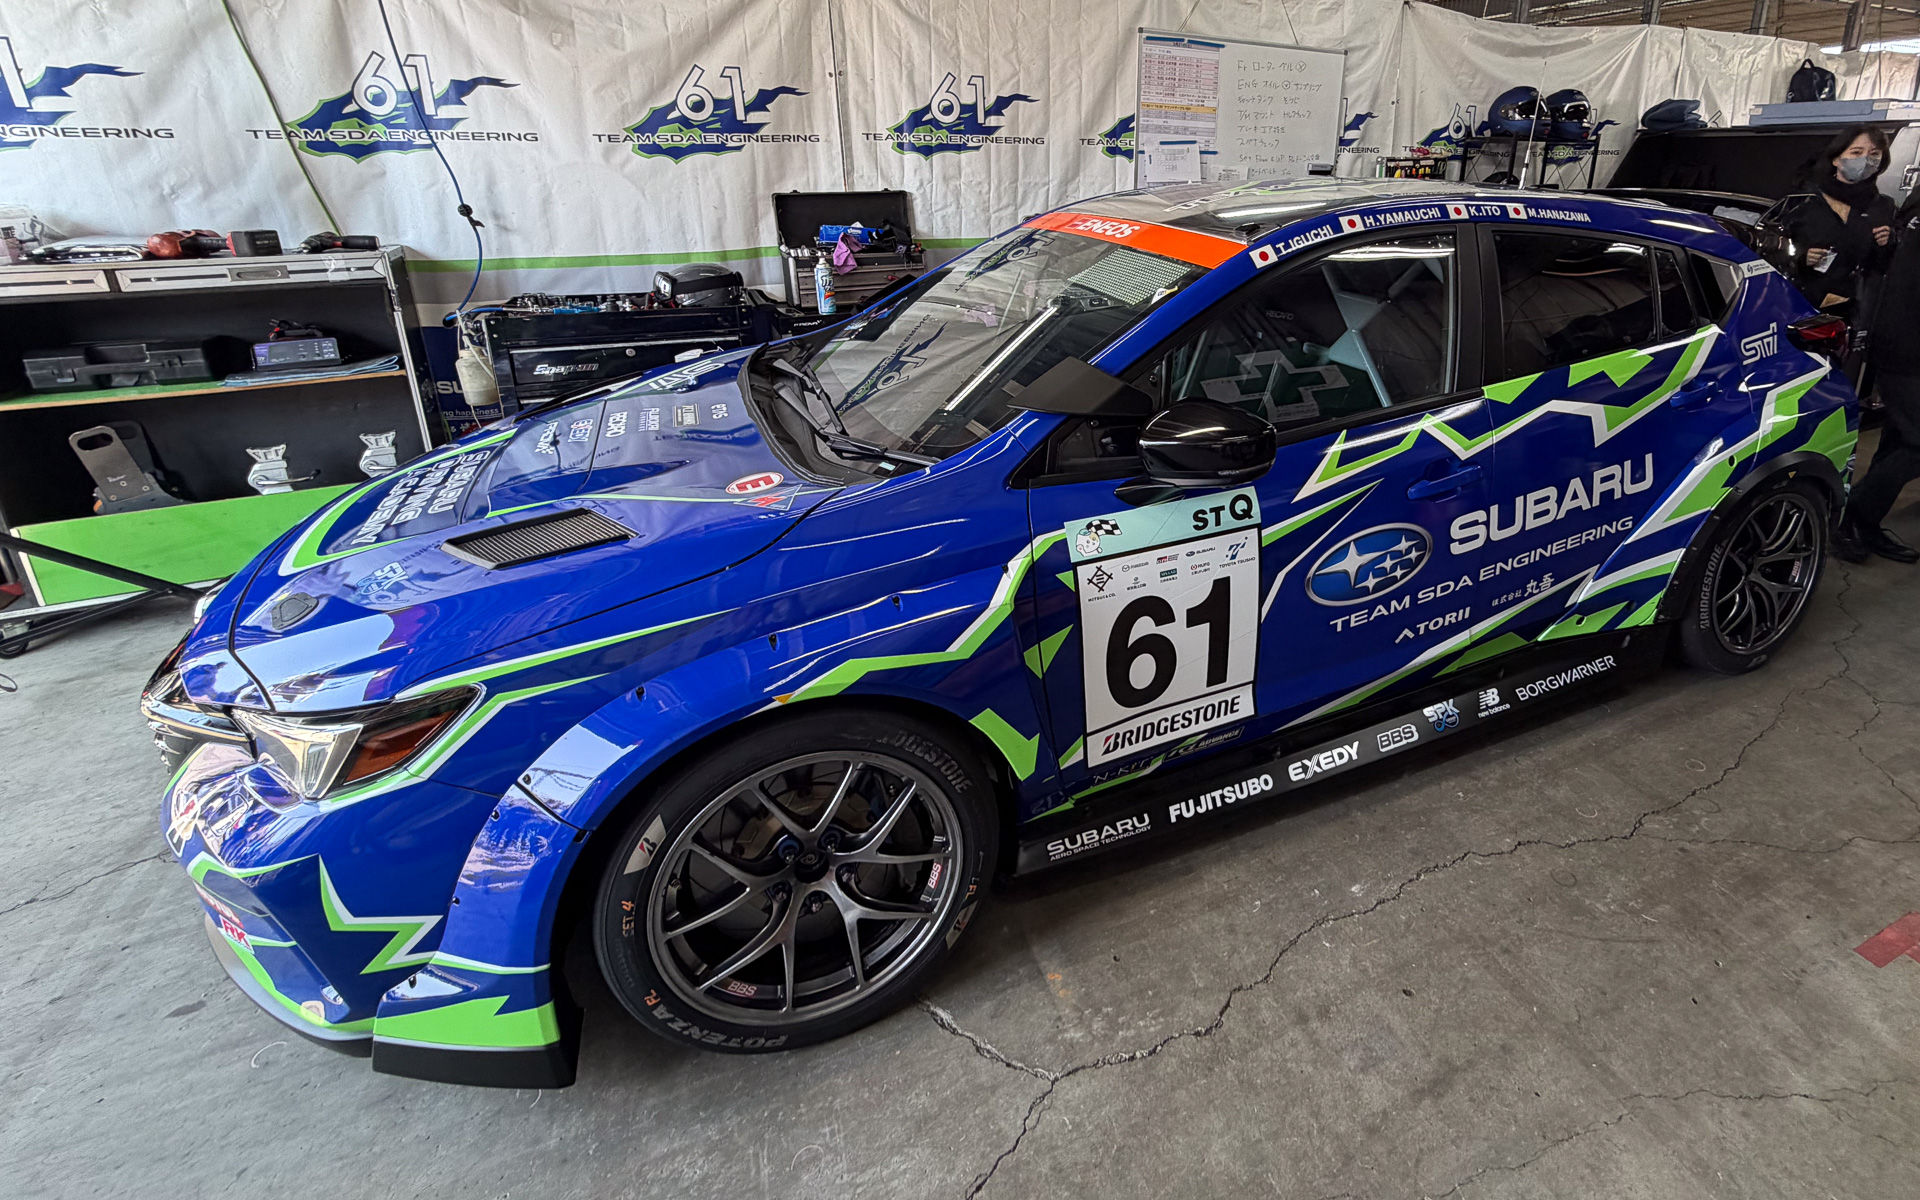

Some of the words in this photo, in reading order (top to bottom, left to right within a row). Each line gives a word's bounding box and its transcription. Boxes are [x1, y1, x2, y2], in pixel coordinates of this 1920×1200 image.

[352, 51, 437, 116] 61
[675, 64, 746, 121] 61
[930, 72, 986, 124] 61
[1237, 79, 1258, 90] ENG
[246, 129, 326, 140] TEAM
[328, 130, 386, 141] SDA
[388, 130, 539, 142] ENGINEERING
[592, 133, 652, 143] TEAM
[655, 133, 699, 143] SDA
[702, 133, 820, 143] ENGINEERING
[862, 132, 910, 142] TEAM
[912, 133, 947, 143] SDA
[949, 134, 1045, 145] ENGINEERING
[1079, 138, 1116, 146] TEAM
[1077, 217, 1141, 239] ENEOS
[1276, 225, 1334, 256] T.IGUCHI
[1364, 206, 1441, 228] H.YAMAUCHI
[1469, 205, 1501, 217] K.ITO
[1528, 207, 1592, 223] M.HANAZAWA
[1740, 322, 1777, 366] STI
[533, 362, 600, 376] Snap-on
[605, 411, 628, 438] RECARO
[391, 456, 459, 525] DRIVING
[427, 450, 491, 514] SUBARU
[351, 466, 432, 545] ACADEMY
[1450, 453, 1654, 556] SUBARU
[1237, 557, 1256, 565] TSUSHO
[1330, 595, 1411, 632] TEAM
[1417, 575, 1473, 605] SDA
[1479, 516, 1634, 581] ENGINEERING
[1700, 543, 1722, 629] BRIDGESTONE
[1106, 576, 1231, 709] 61
[1515, 655, 1617, 701] BORGWARNER
[1101, 695, 1241, 756] BRIDGESTONE
[1422, 698, 1461, 723] SPK
[1478, 711, 1490, 719] new
[1488, 703, 1511, 715] balance
[1377, 723, 1419, 753] BBS
[1288, 743, 1360, 783] EXEDY
[1168, 774, 1274, 823] FUJITSUBO
[1047, 813, 1150, 857] SUBARU
[1050, 849, 1073, 861] AERO
[1073, 841, 1100, 855] SPACE
[1101, 824, 1152, 845] TECHNOLOGY
[928, 862, 942, 889] BBS
[727, 981, 758, 997] BBS
[651, 1003, 789, 1049] POTENZA
